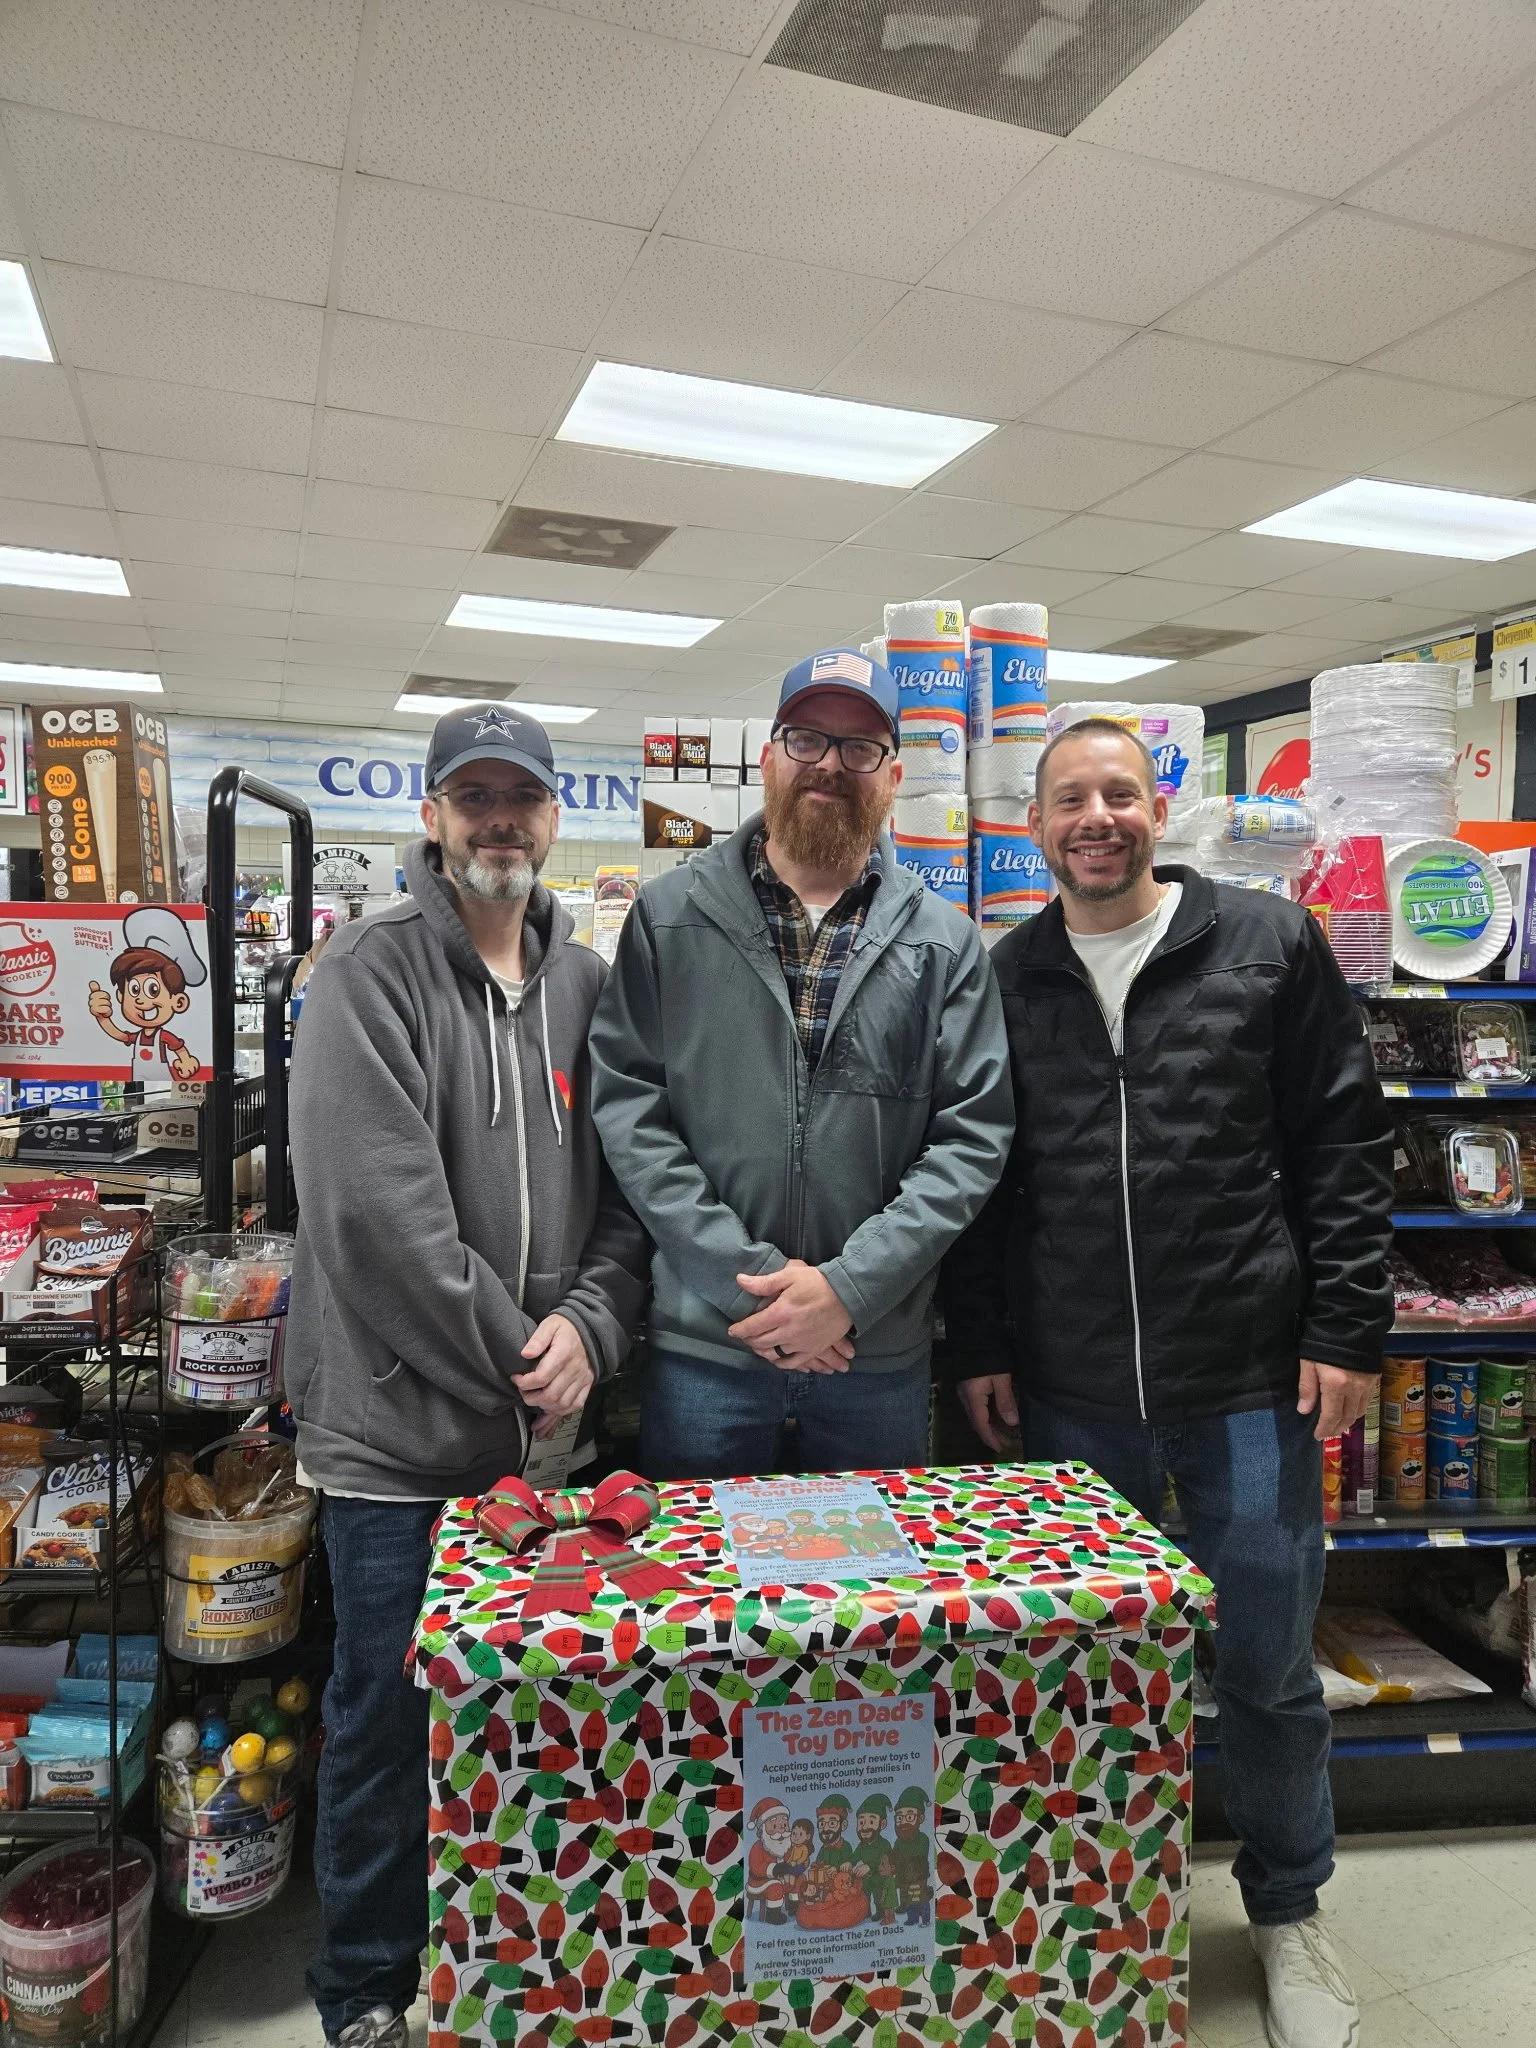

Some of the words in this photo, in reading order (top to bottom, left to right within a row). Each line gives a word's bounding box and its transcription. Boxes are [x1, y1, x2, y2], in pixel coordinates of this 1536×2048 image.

[945, 612, 957, 625] 70
[1496, 626, 1533, 646] Cheyenne
[1500, 661, 1507, 679] $
[42, 709, 119, 734] OCB
[136, 712, 166, 746] OCB
[47, 736, 117, 748] Unbleached
[649, 742, 673, 750] Black
[682, 743, 706, 751] Black
[653, 750, 673, 758] Mild
[48, 774, 72, 785] 900
[70, 797, 91, 859] Cone
[150, 801, 160, 860] Cone
[665, 820, 694, 829] Black
[671, 829, 694, 837] Mild
[319, 848, 360, 861] AMISH
[1468, 881, 1485, 889] 100
[1408, 894, 1492, 924] EILAT
[74, 931, 102, 943] SWEET
[102, 936, 109, 944] &
[0, 947, 51, 971] lassic
[178, 1082, 206, 1094] OC
[34, 1125, 80, 1141] OCB
[119, 1125, 132, 1141] OCB
[148, 1122, 195, 1138] OCB
[45, 1227, 133, 1266] Brownie
[21, 1325, 36, 1333] Soft
[210, 1331, 241, 1340] AMISH
[185, 1361, 215, 1372] ROCK
[219, 1362, 261, 1372] CANDY
[1431, 1401, 1456, 1414] PRINGLES
[725, 1483, 762, 1493] The
[764, 1480, 803, 1489] Zen
[807, 1478, 863, 1488] Dad's
[748, 1489, 785, 1498] Toy
[791, 1486, 846, 1495] Drive
[1443, 1478, 1470, 1490] PRINGLES
[34, 1560, 49, 1568] Soft
[54, 1560, 85, 1568] Delicious
[231, 1563, 271, 1576] AMISH
[203, 1608, 252, 1624] HONEY
[756, 1711, 802, 1734] The
[806, 1706, 852, 1729] Zen
[858, 1699, 924, 1724] Dad's
[781, 1732, 828, 1757] Toy
[833, 1725, 900, 1750] Drive
[762, 1761, 808, 1774] Accepting
[810, 1757, 855, 1769] donations
[857, 1755, 867, 1764] of
[868, 1755, 888, 1763] new
[889, 1752, 909, 1762] toys
[910, 1751, 921, 1760] to
[49, 1771, 91, 1780] CINNABON
[769, 1774, 789, 1785] help
[790, 1770, 831, 1781] Venango
[832, 1767, 864, 1778] County
[866, 1763, 900, 1774] families
[902, 1762, 911, 1771] in
[785, 1783, 808, 1793] need
[809, 1781, 827, 1791] this
[828, 1778, 861, 1789] holiday
[862, 1776, 894, 1785] season
[234, 1832, 270, 1849] AMISH
[202, 1875, 252, 1901] JUMBO
[756, 1940, 776, 1949] Feel
[776, 1939, 796, 1948] free
[797, 1936, 808, 1945] to
[809, 1932, 844, 1944] contact
[845, 1931, 862, 1941] The
[864, 1928, 880, 1938] Zen
[882, 1925, 905, 1936] Dads
[782, 1948, 796, 1957] for
[798, 1947, 821, 1956] more
[823, 1940, 875, 1954] information
[877, 1947, 894, 1957] Tim
[895, 1944, 919, 1955] Tobin
[754, 1960, 790, 1971] Andrew
[791, 1955, 834, 1968] Shipwash
[870, 1953, 926, 1969] 412-706-4603
[6, 1975, 77, 2001] CINNAMON
